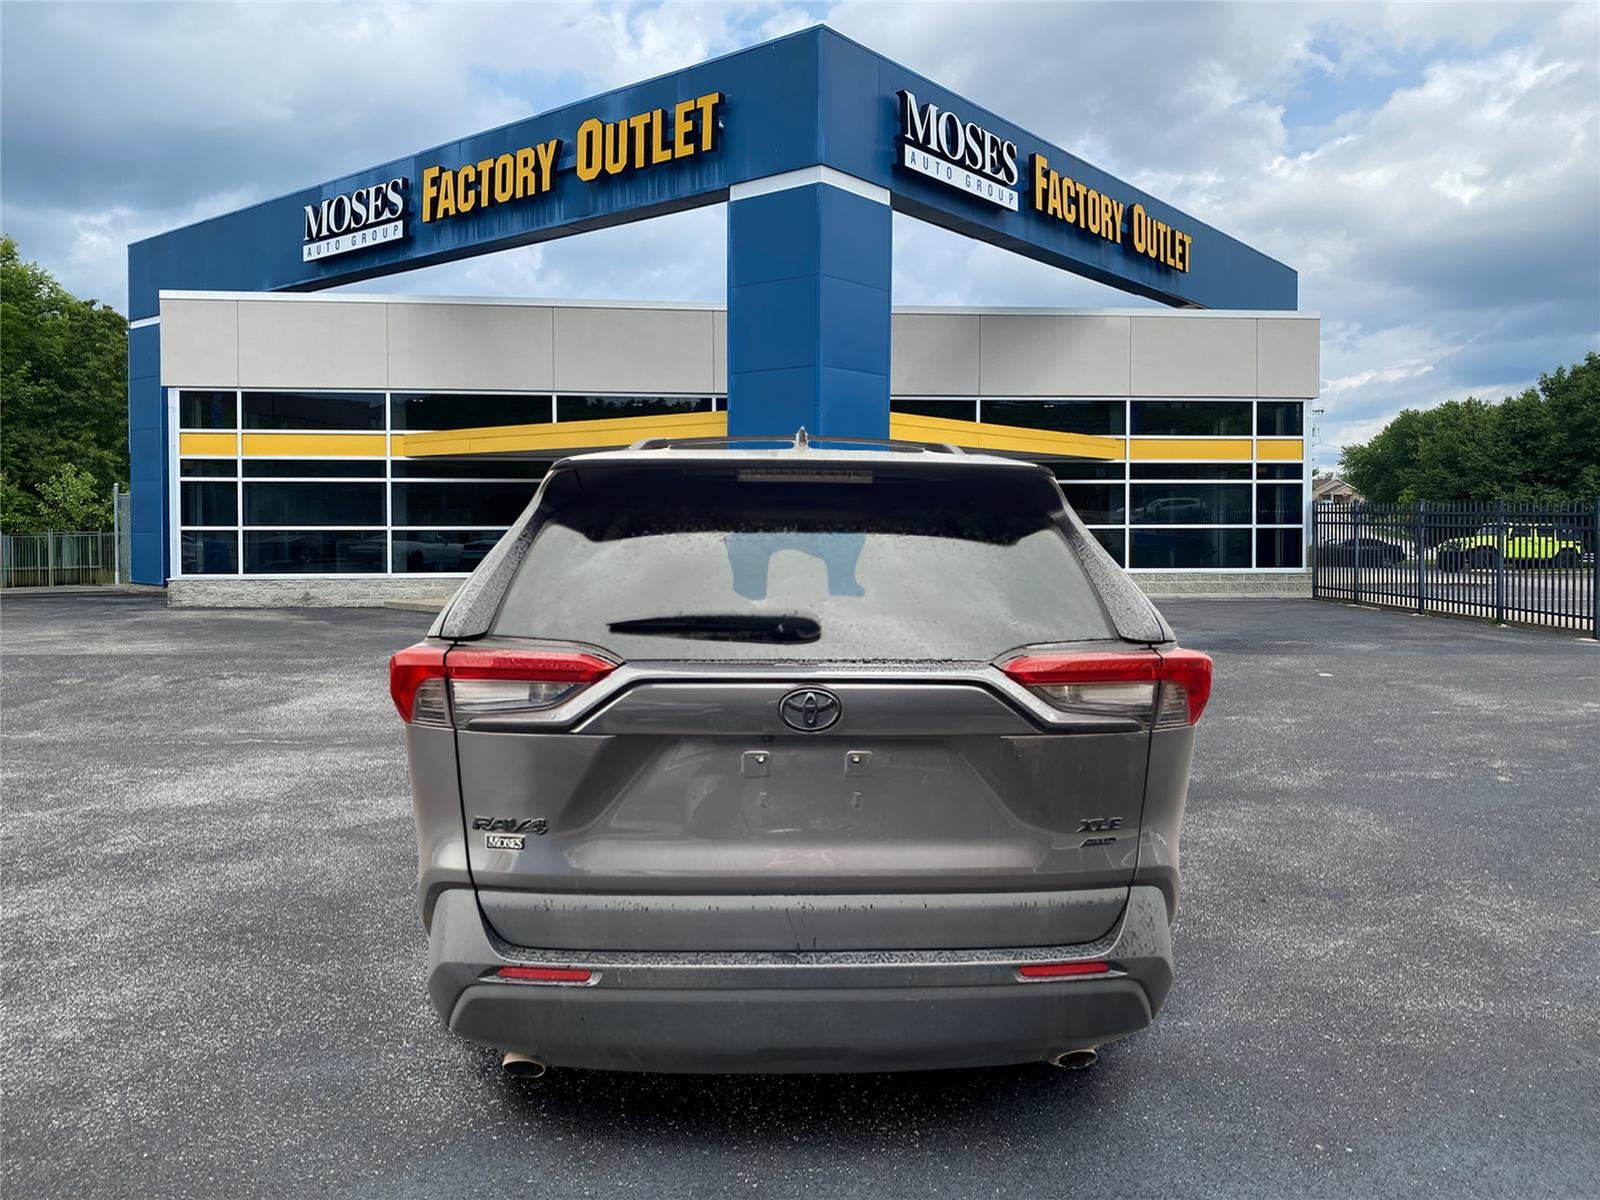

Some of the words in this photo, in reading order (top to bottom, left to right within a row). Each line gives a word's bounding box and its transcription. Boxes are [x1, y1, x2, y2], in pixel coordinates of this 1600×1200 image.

[422, 139, 558, 223] FACTORY
[576, 92, 720, 181] OUTLET
[904, 90, 1018, 187] MOSES
[910, 151, 953, 180] AUTO
[965, 174, 1014, 204] GROUP
[303, 178, 404, 242] MOSES
[307, 239, 341, 258] AUTO
[351, 224, 399, 247] GROUP
[1035, 153, 1124, 244] FACTORY
[1131, 202, 1192, 273] OUTLET
[472, 815, 549, 836] RAV4
